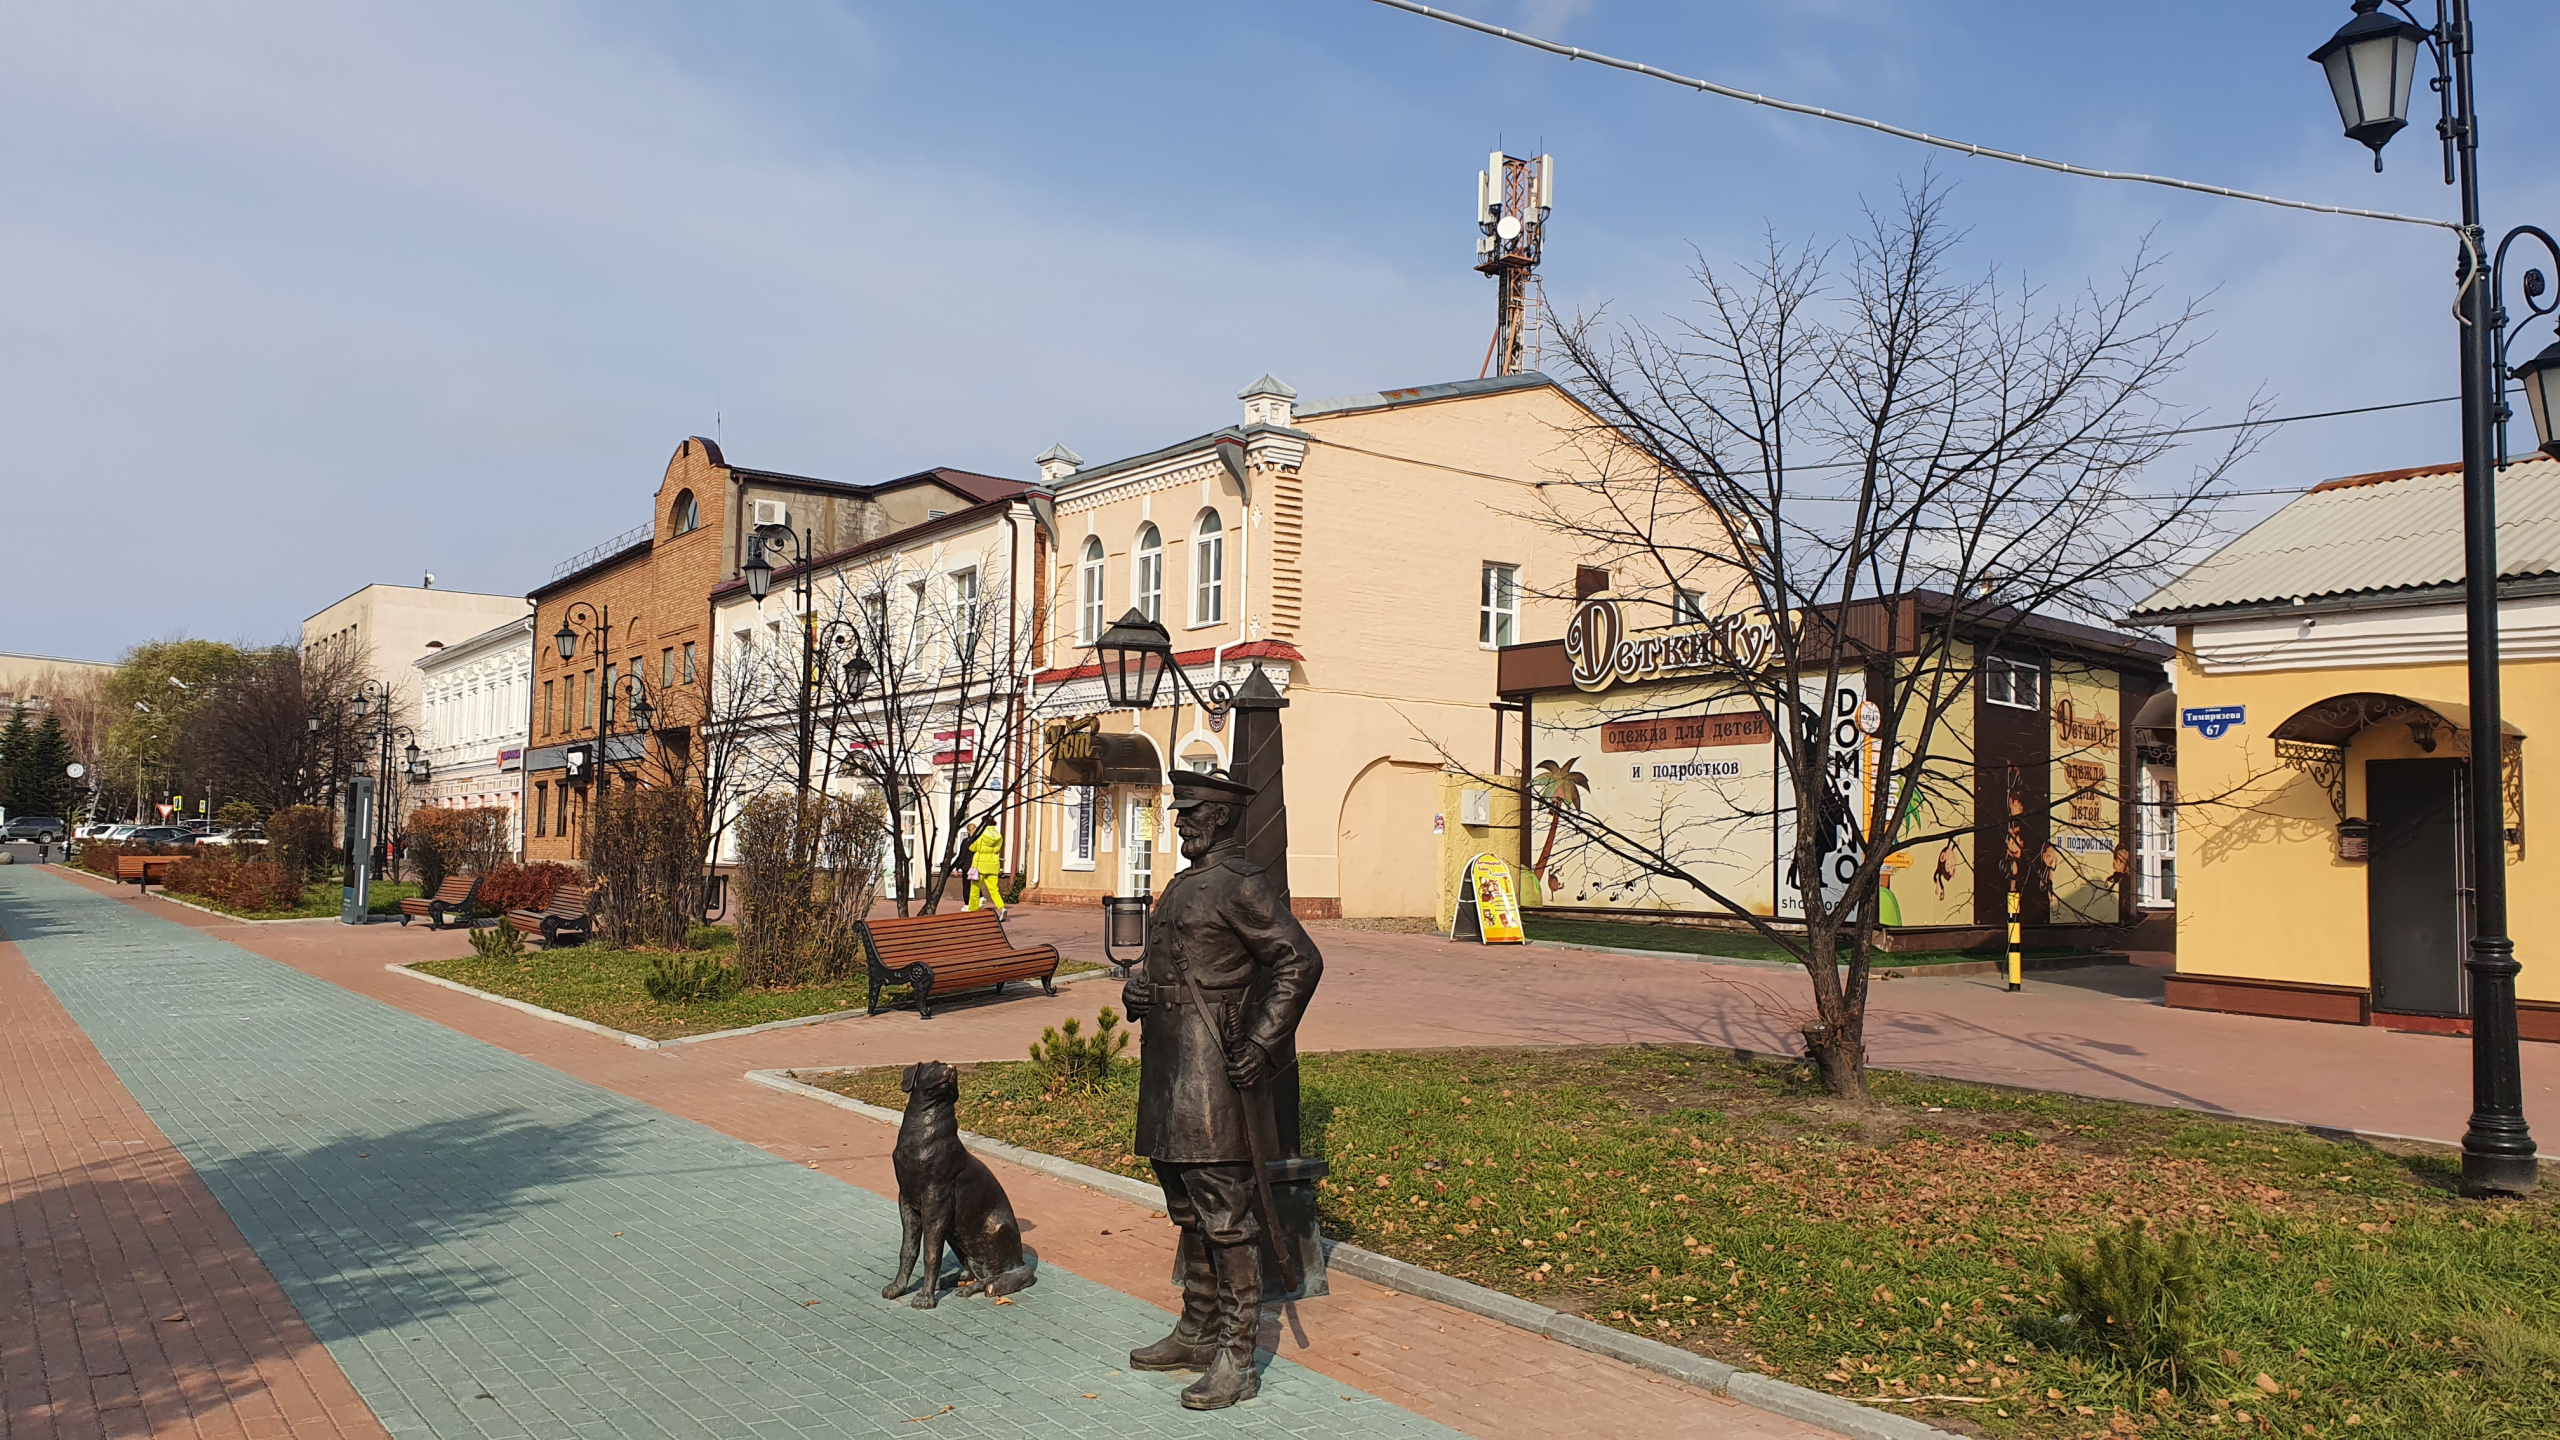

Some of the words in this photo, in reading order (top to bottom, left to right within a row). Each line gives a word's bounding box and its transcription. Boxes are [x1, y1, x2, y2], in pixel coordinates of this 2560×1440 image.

[2185, 712, 2241, 723] Тимирязева
[1608, 727, 1668, 747] одежда
[1674, 723, 1705, 744] для
[1713, 715, 1764, 742] детей
[2206, 724, 2220, 736] 67
[1632, 766, 1641, 778] и
[1652, 761, 1739, 781] подростков
[2066, 764, 2105, 781] одежда
[2071, 802, 2100, 823] детей
[2066, 836, 2113, 853] подростков
